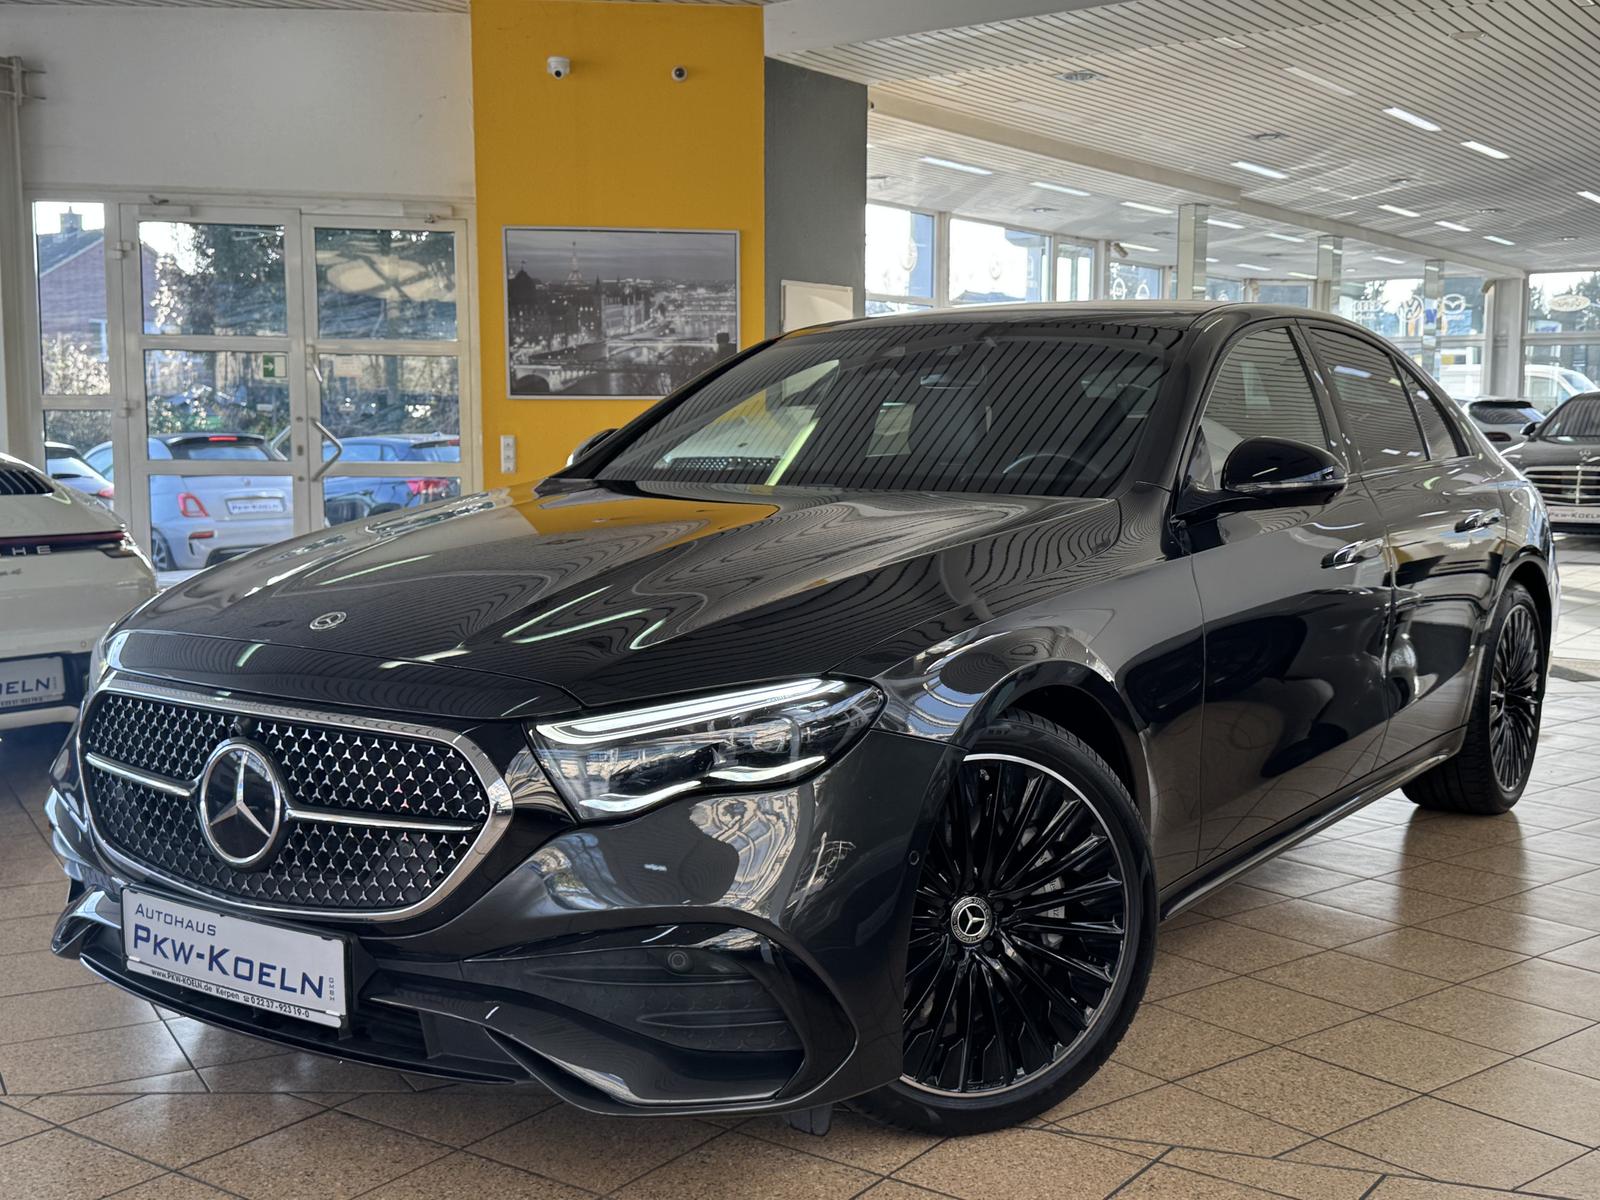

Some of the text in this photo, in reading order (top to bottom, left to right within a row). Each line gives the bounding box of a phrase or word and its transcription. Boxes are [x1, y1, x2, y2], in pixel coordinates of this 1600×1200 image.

[0, 544, 51, 556] HE
[135, 903, 217, 936] AUTOHAUS
[133, 923, 324, 999] PKW-KOELN
[215, 985, 240, 1000] Kerpen
